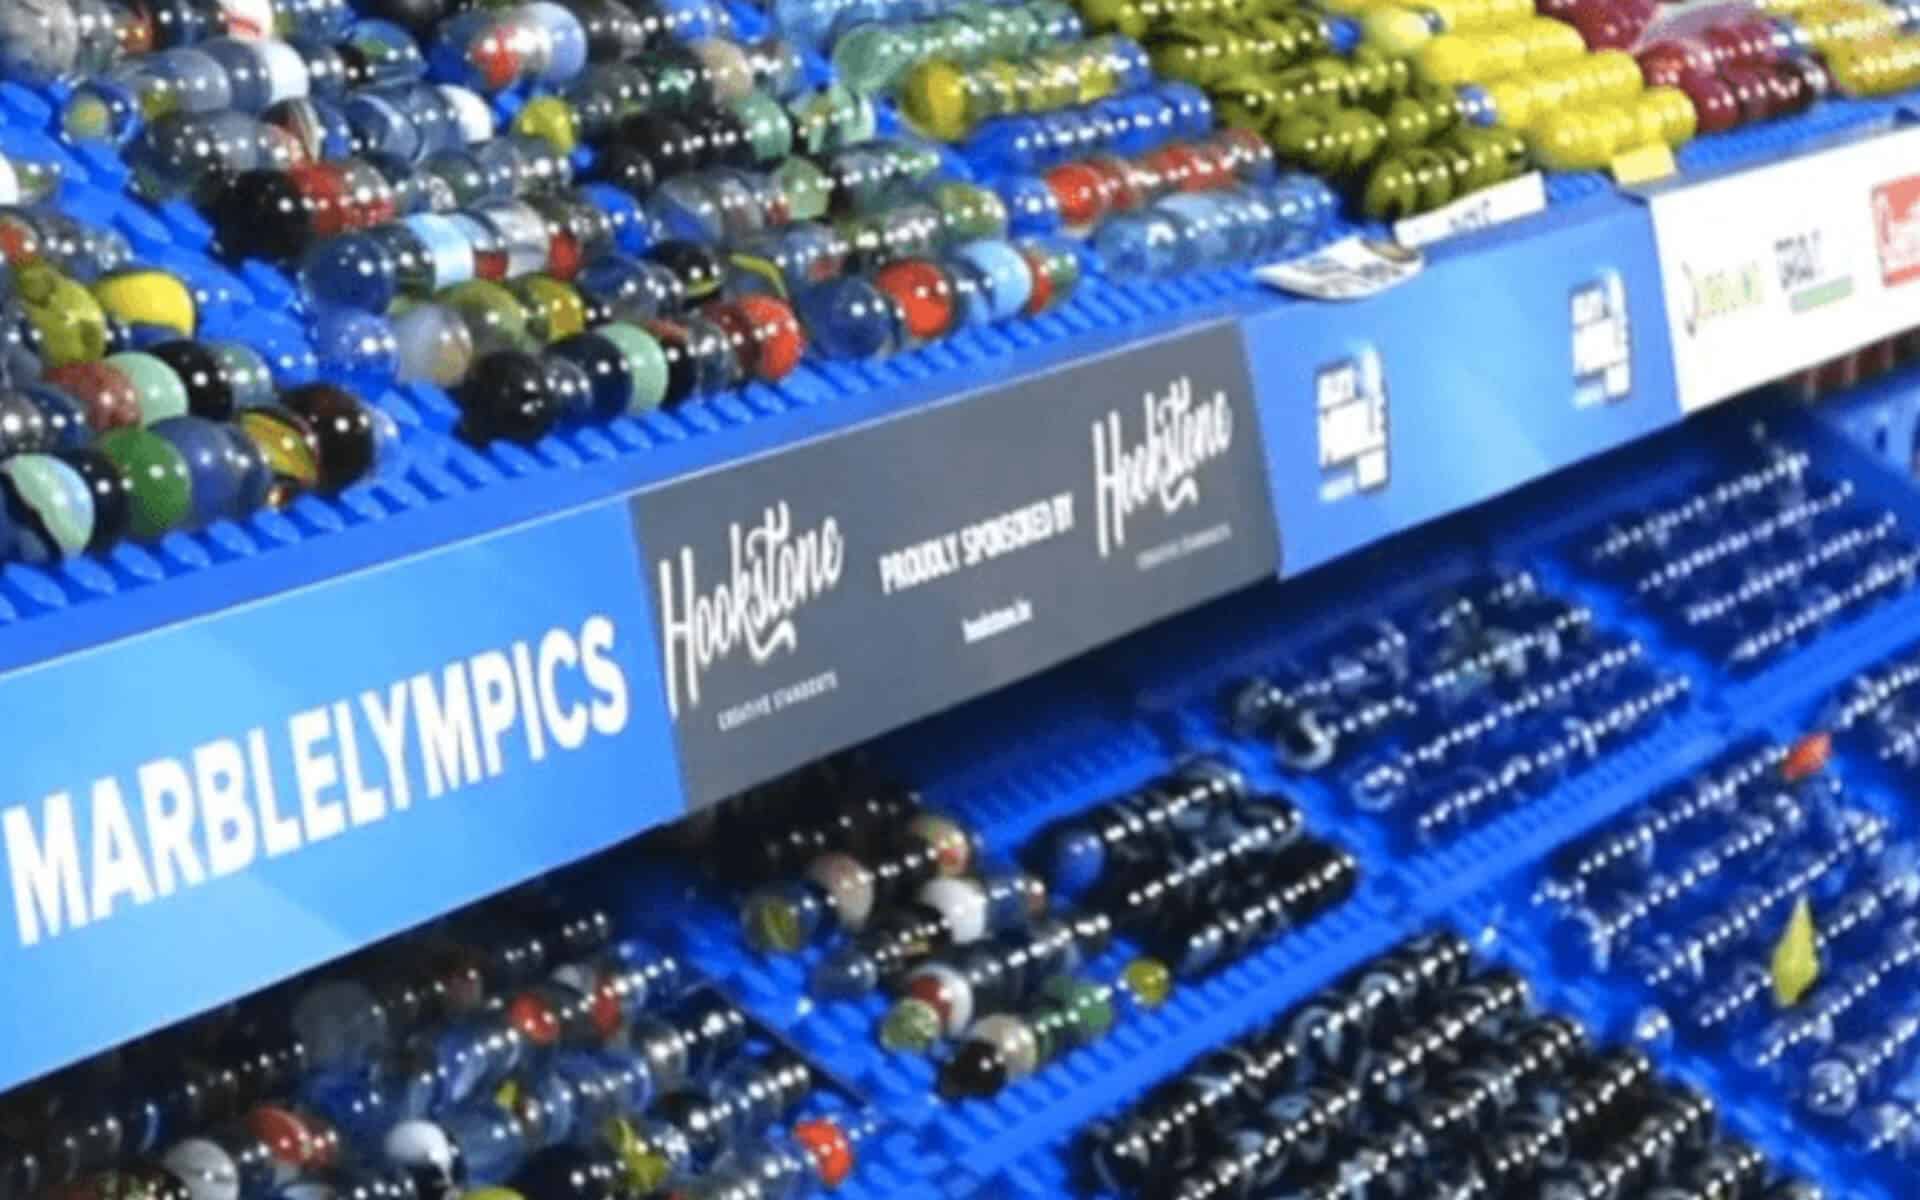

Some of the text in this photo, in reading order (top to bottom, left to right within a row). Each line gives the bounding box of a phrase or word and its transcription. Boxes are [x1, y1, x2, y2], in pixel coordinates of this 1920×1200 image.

[879, 532, 961, 595] PROUDLY
[1091, 374, 1233, 558] Hookstone
[658, 499, 844, 722] Hookstone
[3, 616, 629, 947] MARBLELYMPICS
